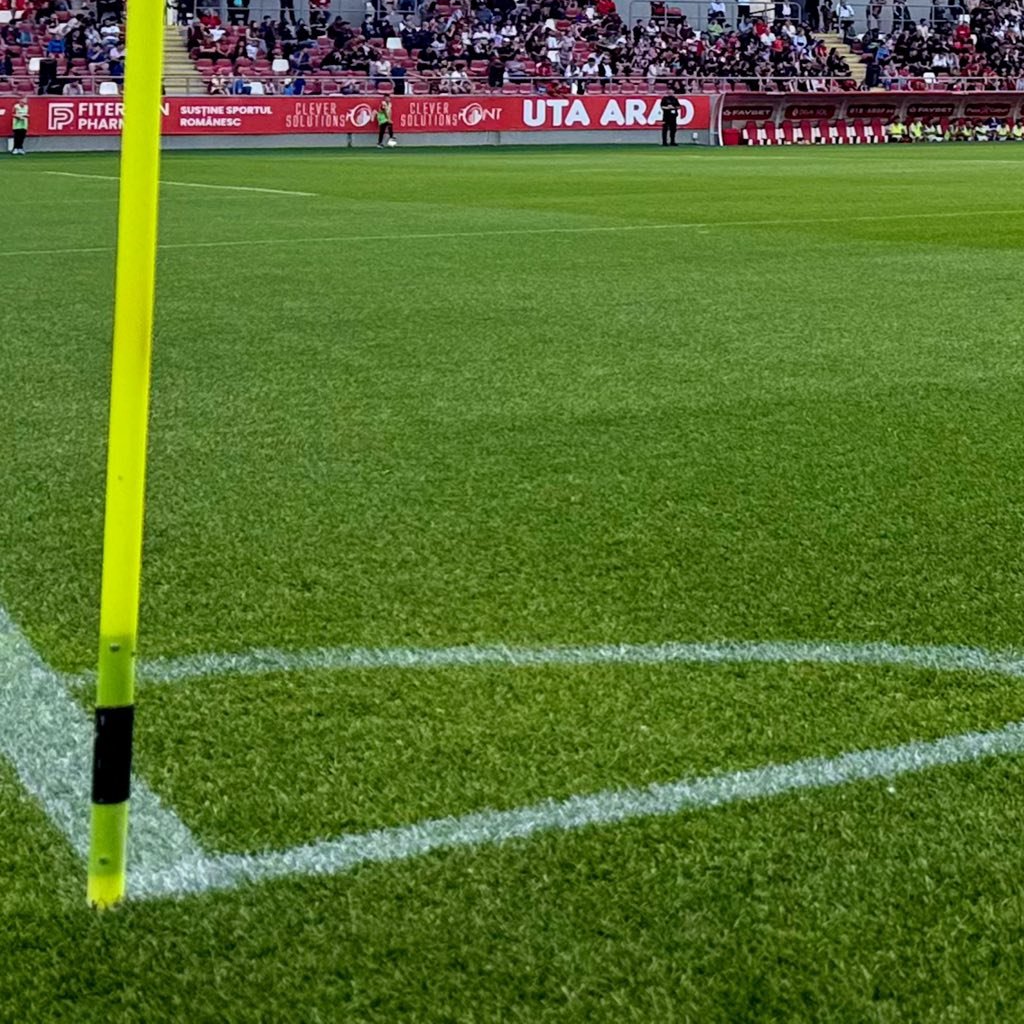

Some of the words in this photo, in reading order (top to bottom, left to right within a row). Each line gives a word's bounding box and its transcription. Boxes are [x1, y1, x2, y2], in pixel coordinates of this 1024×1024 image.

[78, 102, 170, 116] FITERN
[226, 106, 273, 115] SPORTUL
[295, 102, 337, 115] CLEVER
[409, 102, 449, 114] CLEVER
[523, 99, 590, 126] UTA
[600, 99, 695, 126] ARAD
[285, 114, 346, 127] SOLUTIONS
[400, 113, 458, 127] SOLUTIONS
